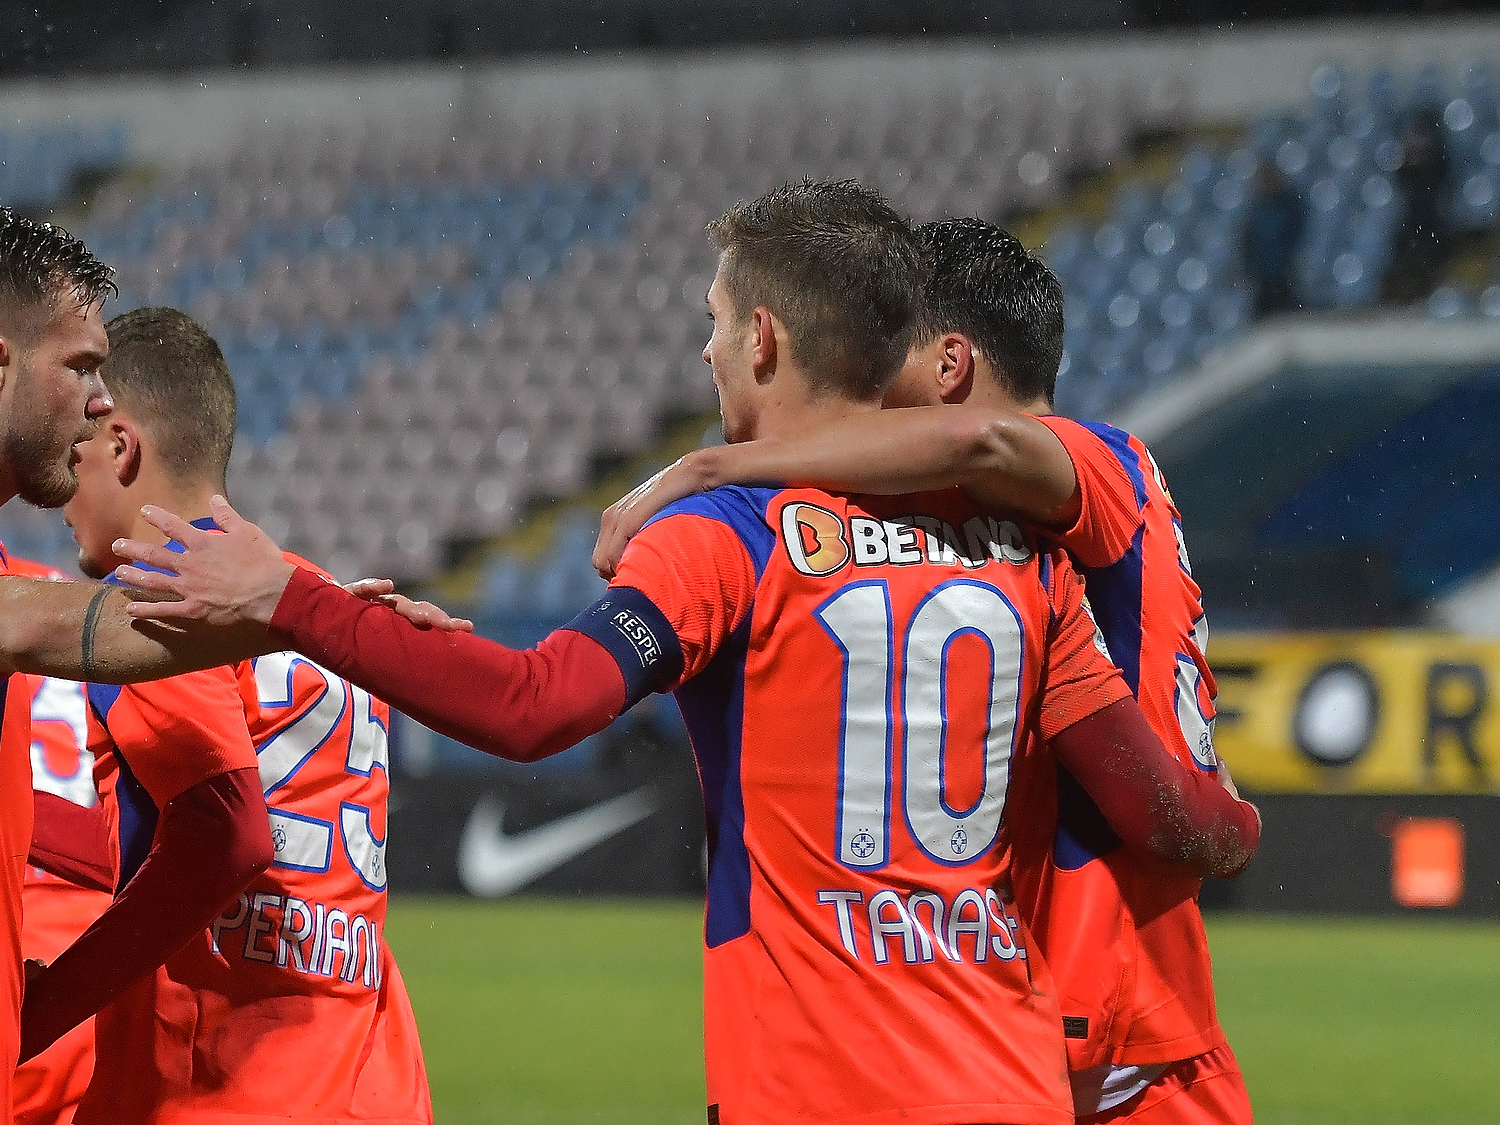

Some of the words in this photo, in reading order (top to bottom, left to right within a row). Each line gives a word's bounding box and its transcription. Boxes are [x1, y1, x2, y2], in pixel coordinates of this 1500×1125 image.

[849, 515, 1035, 570] BETANO
[250, 650, 390, 894] 25
[812, 579, 1025, 871] 10
